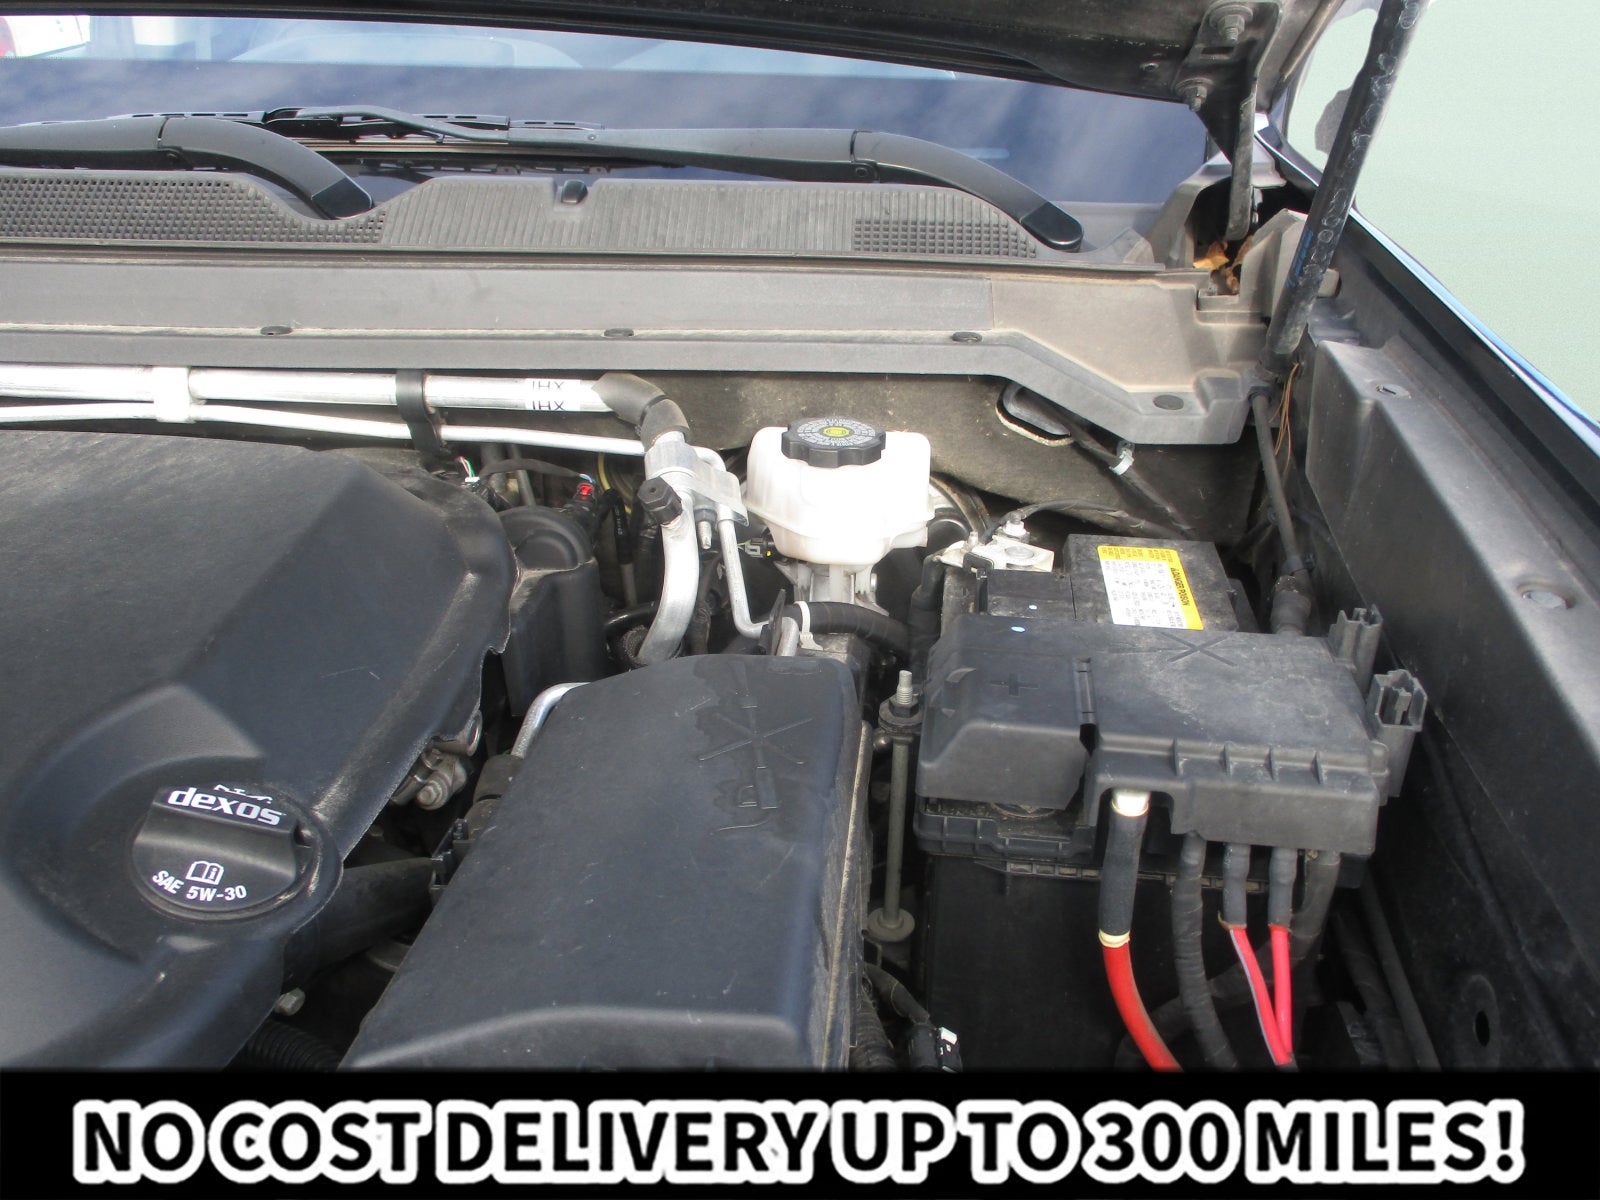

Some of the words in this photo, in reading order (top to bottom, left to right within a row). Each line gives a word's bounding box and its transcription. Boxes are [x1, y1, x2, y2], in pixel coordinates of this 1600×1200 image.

[168, 787, 281, 825] dexos
[152, 870, 185, 894] SAE
[186, 884, 248, 902] 5W-30
